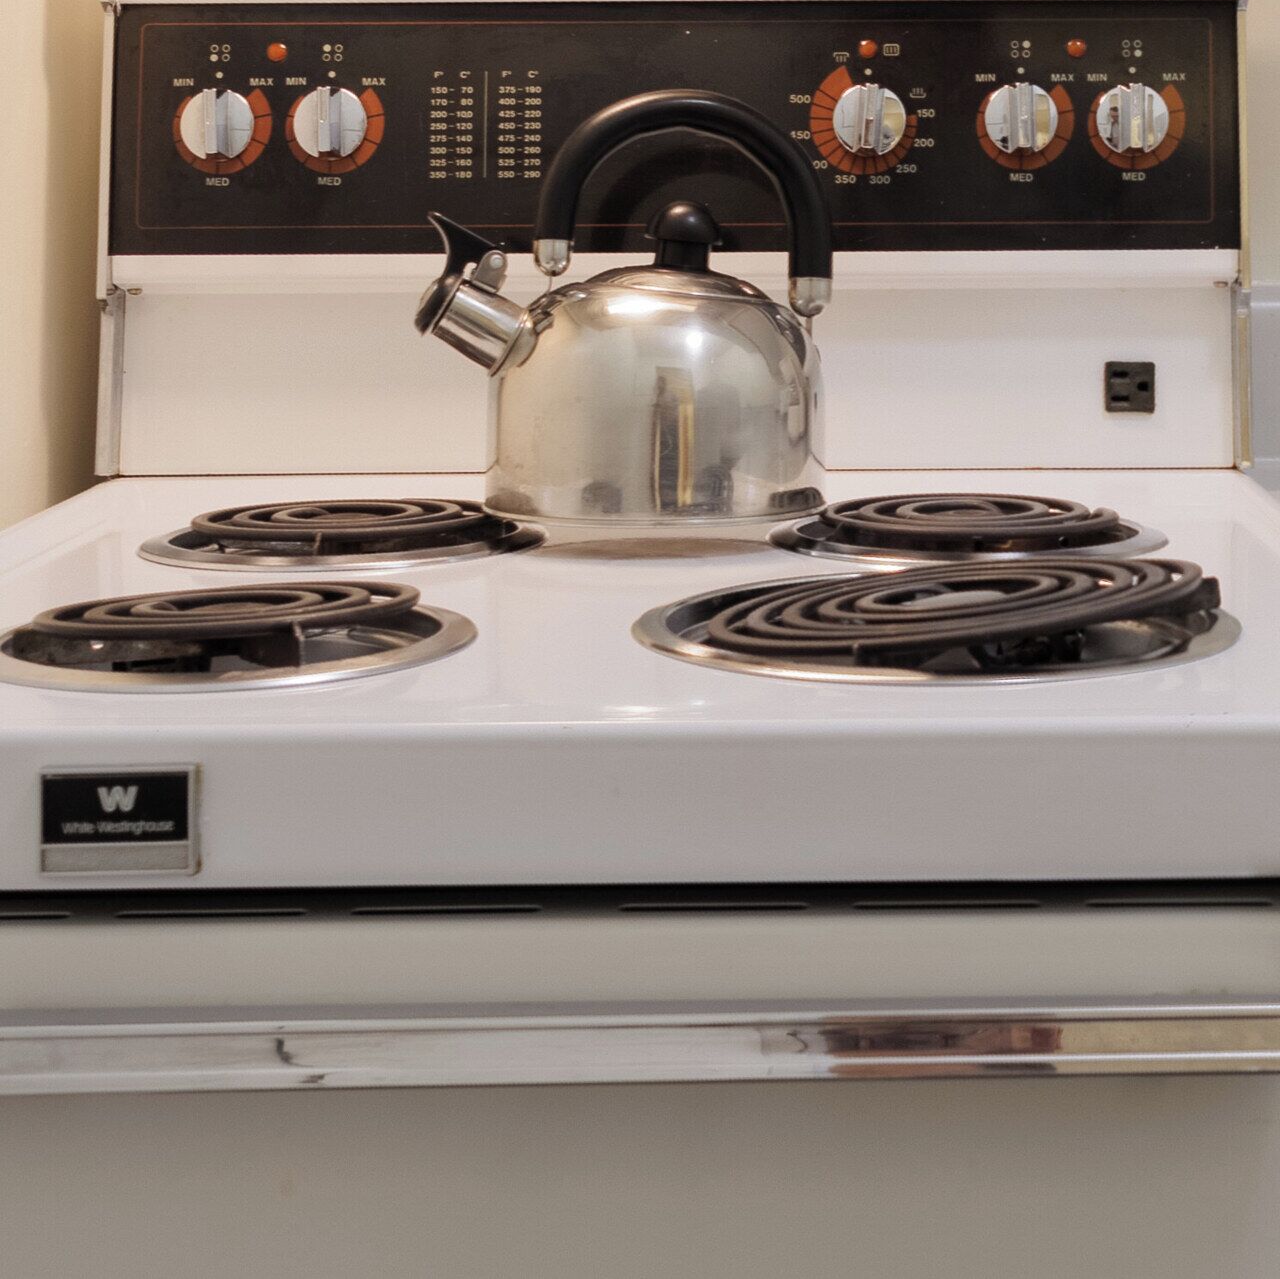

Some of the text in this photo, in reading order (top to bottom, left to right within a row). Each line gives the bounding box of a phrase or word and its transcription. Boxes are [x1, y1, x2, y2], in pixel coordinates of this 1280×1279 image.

[975, 73, 996, 82] MIN
[1051, 73, 1075, 82] MAX
[1087, 73, 1108, 82] MIN
[1162, 72, 1186, 81] MAX
[173, 78, 194, 87] MIN
[250, 77, 274, 86] MAX
[286, 77, 307, 86] MIN
[362, 77, 386, 86] MAX
[431, 86, 473, 94] 150 70
[498, 86, 542, 94] 375 190
[431, 98, 473, 106] 170 80
[498, 98, 542, 106] 400 200
[790, 95, 811, 104] 500
[430, 110, 473, 118] 200 100
[498, 110, 542, 118] 425 220
[917, 109, 936, 118] 150
[430, 122, 473, 130] 250 120
[498, 122, 542, 130] 450 230
[430, 134, 473, 142] 275 140
[498, 134, 542, 142] 475 240
[914, 138, 934, 147] 200
[430, 147, 473, 155] 300 150
[498, 147, 541, 155] 500 260
[429, 159, 473, 167] 325 160
[498, 159, 541, 167] 525 270
[813, 160, 828, 169] 00
[896, 164, 917, 173] 250
[429, 171, 473, 179] 350 180
[498, 171, 541, 179] 550 290
[835, 175, 857, 184] 350
[869, 175, 891, 184] 300
[1009, 173, 1033, 182] MED
[1122, 172, 1146, 181] MED
[205, 177, 230, 186] MED
[318, 177, 342, 186] MED
[97, 786, 139, 812] W
